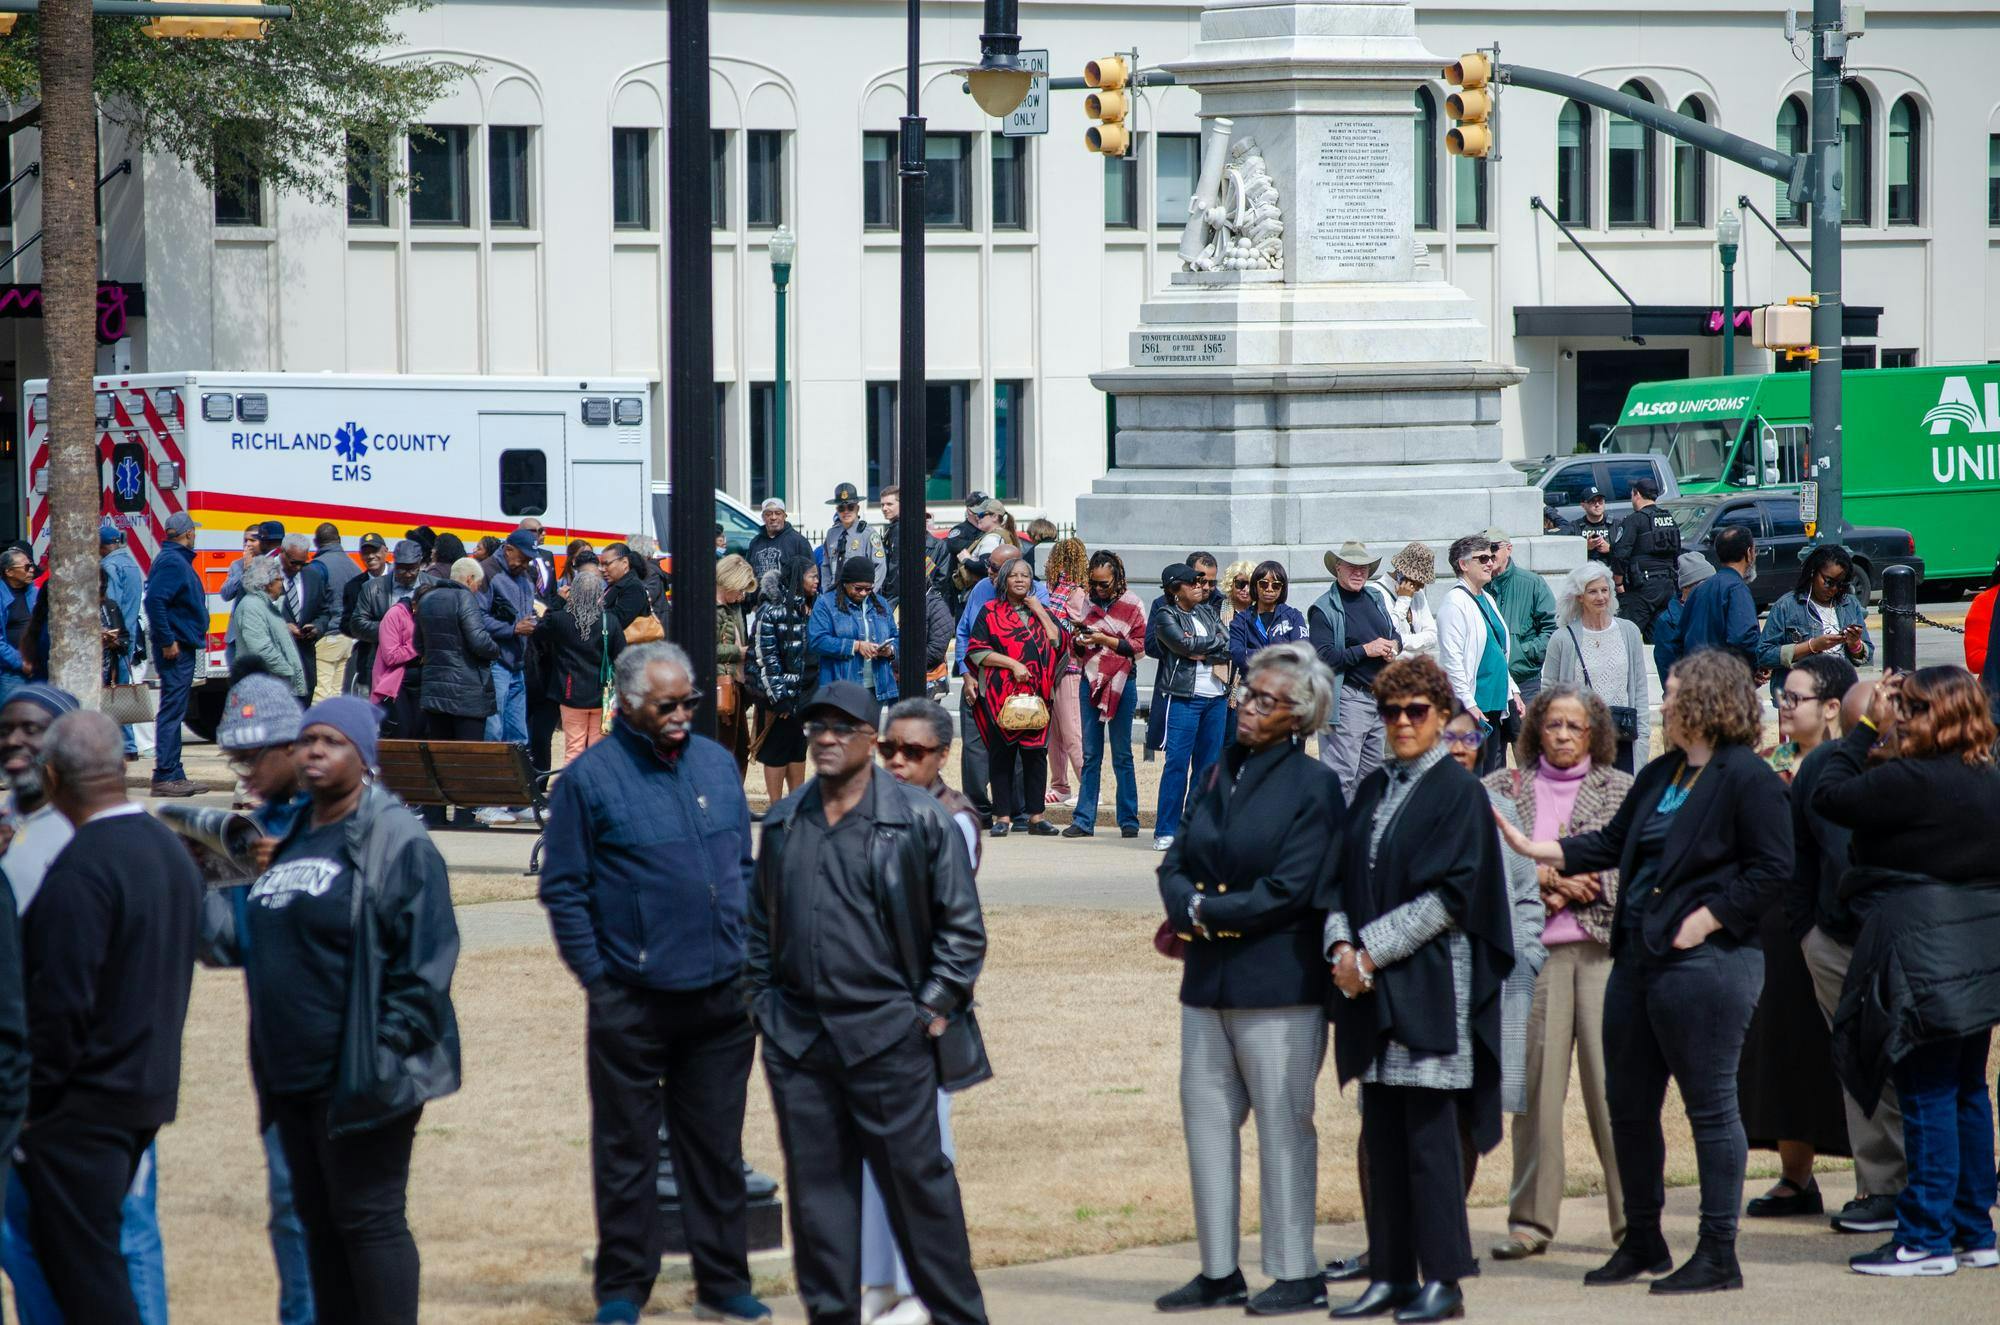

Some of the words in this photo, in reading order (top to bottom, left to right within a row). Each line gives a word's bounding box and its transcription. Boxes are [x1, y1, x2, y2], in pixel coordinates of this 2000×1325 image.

[1030, 58, 1042, 71] ON
[1014, 112, 1036, 126] ONLY
[1628, 401, 1678, 417] ALSCO
[231, 432, 332, 450] RICHLAND
[373, 434, 451, 451] COUNTY
[332, 464, 372, 482] EMS
[1654, 516, 1674, 527] POLICE
